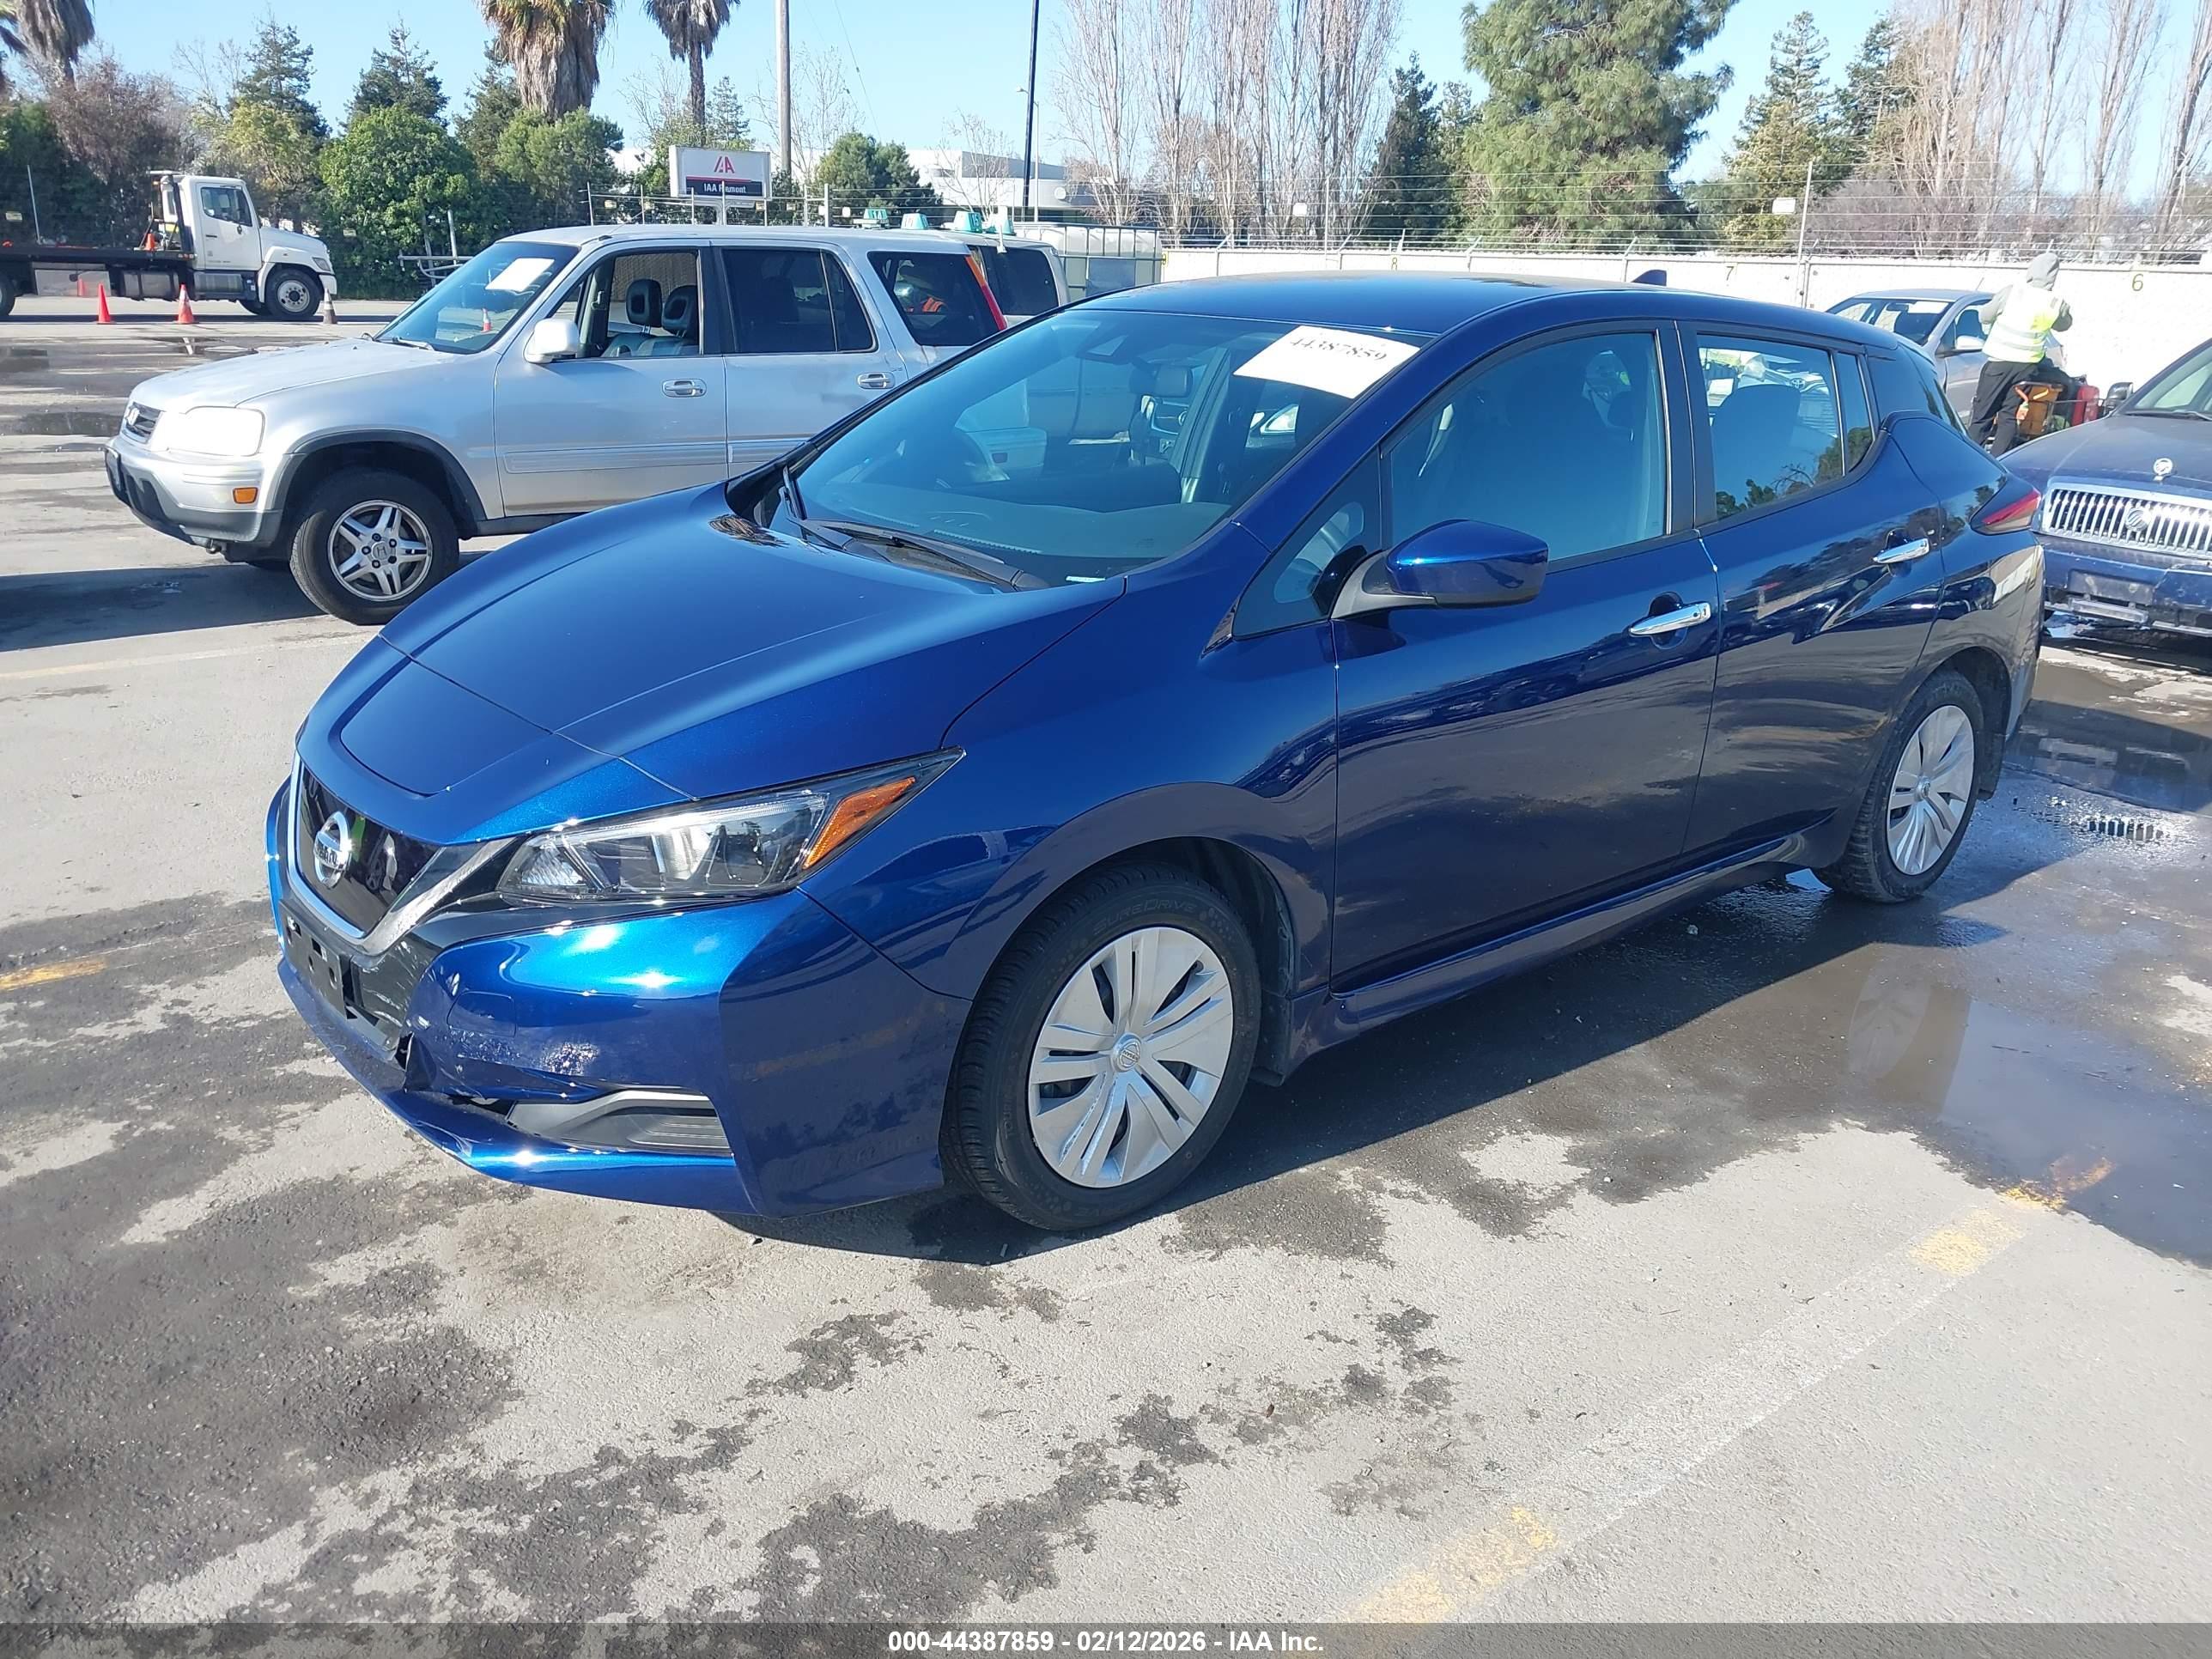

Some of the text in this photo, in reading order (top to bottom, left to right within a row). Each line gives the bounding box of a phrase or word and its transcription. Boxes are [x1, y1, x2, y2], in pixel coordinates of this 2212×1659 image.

[704, 183, 746, 193] IAA Femont
[1726, 265, 1735, 281] 7
[2131, 273, 2144, 292] 6
[1290, 337, 1388, 361] 44387859
